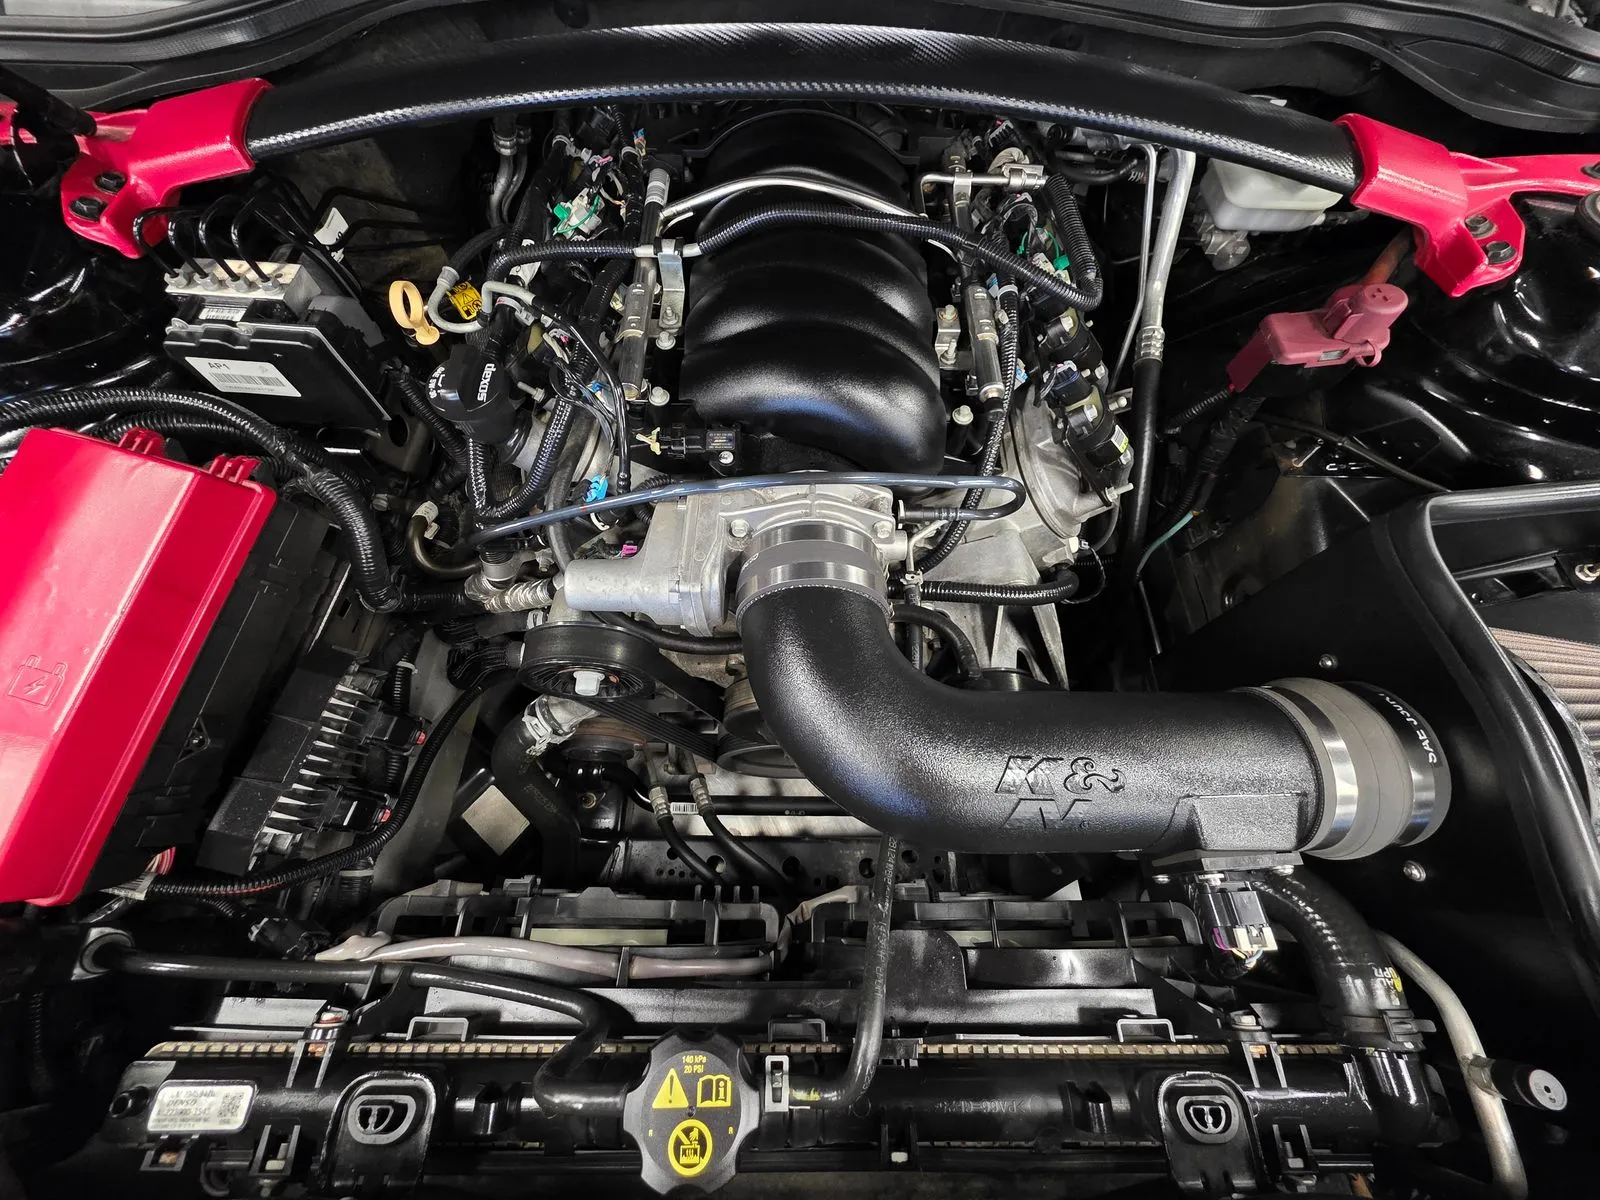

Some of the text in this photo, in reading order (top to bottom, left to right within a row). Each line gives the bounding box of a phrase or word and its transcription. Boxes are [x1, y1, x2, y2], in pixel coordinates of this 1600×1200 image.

[477, 363, 497, 402] dexos
[682, 1055, 707, 1064] 140 kPa
[683, 1064, 704, 1074] 20 PSI
